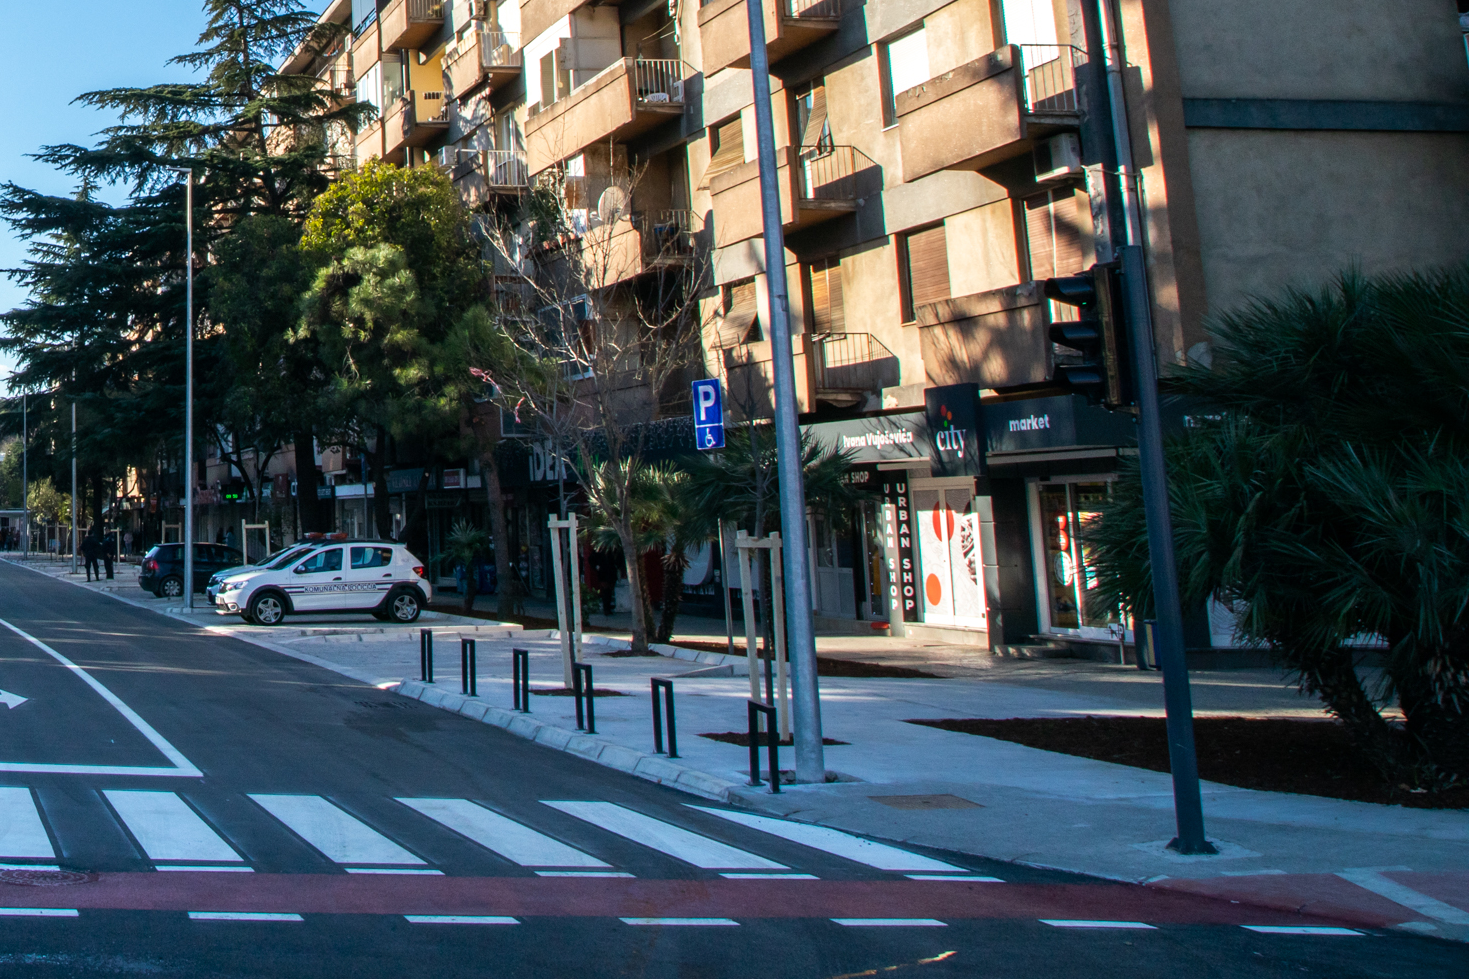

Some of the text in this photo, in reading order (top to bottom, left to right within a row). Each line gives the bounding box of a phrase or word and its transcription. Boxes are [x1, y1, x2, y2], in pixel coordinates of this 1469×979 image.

[698, 385, 716, 421] P
[1008, 414, 1050, 432] market
[843, 435, 866, 448] Ivana
[936, 424, 967, 458] city
[850, 470, 870, 484] SHOP
[896, 483, 915, 611] URBAN SHOP
[304, 583, 377, 593] KOMUNALNA POLICIJA
[888, 557, 899, 611] SHOP
